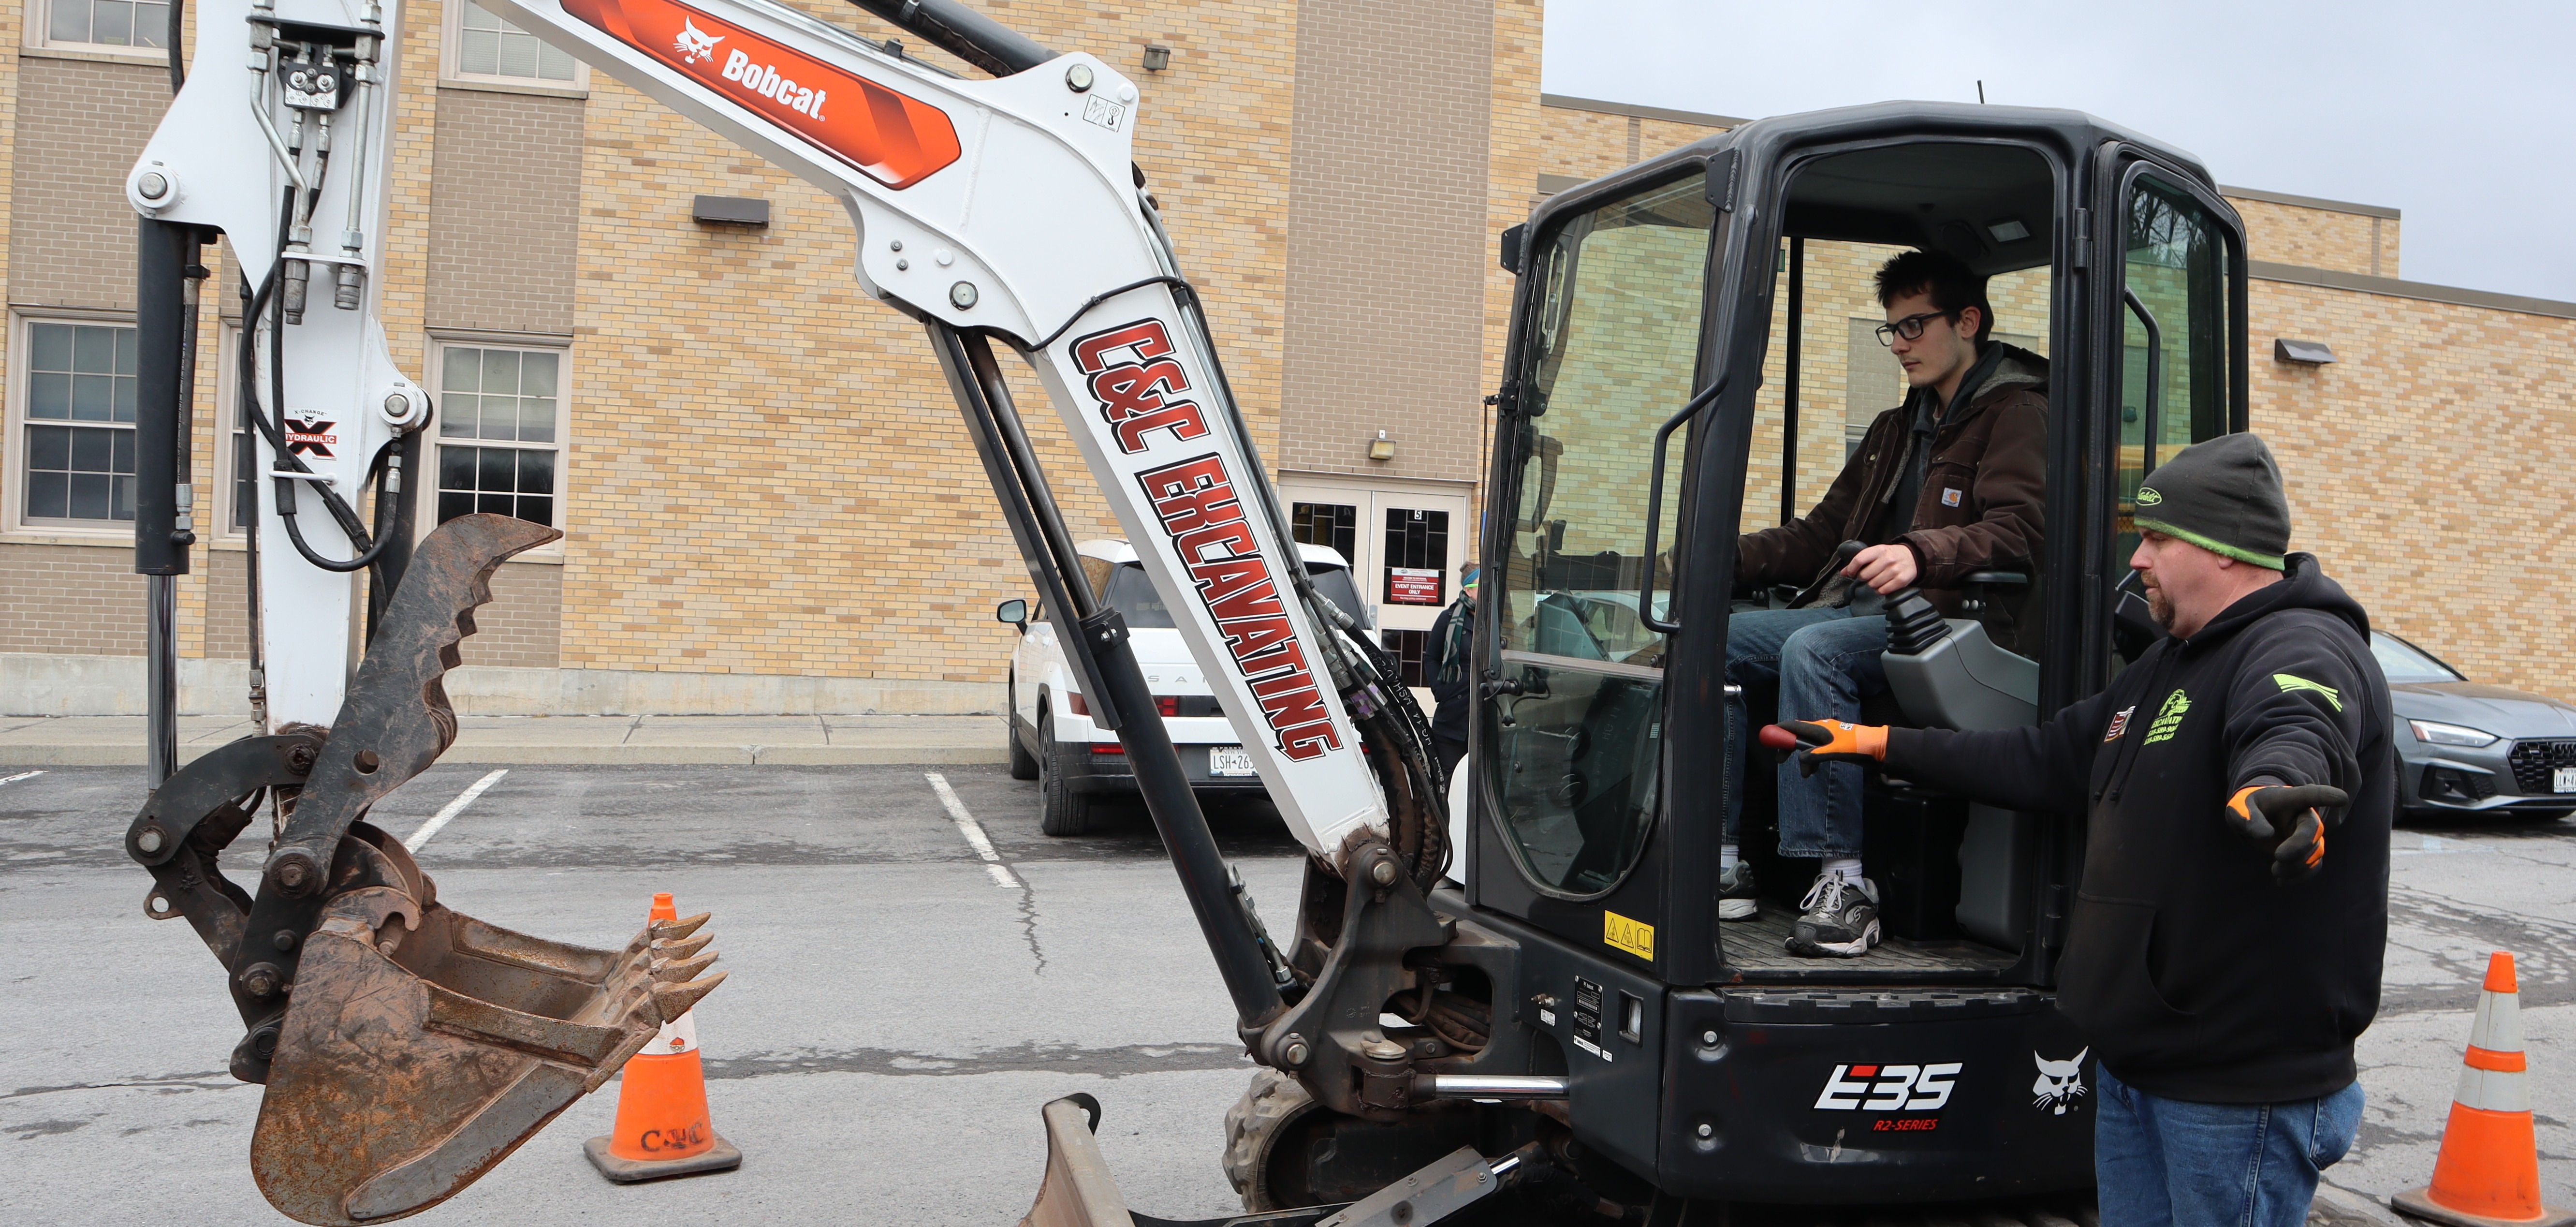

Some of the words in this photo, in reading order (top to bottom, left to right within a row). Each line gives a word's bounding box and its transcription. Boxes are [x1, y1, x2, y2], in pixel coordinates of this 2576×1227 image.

[721, 48, 827, 120] Bobcat
[1069, 317, 1211, 454] C&C
[1416, 510, 1420, 518] 5
[1134, 452, 1343, 763] EXCAVATING
[1214, 755, 1231, 769] LSH
[1814, 1063, 1962, 1110] E35
[1873, 1119, 1938, 1131] R2-SERIES
